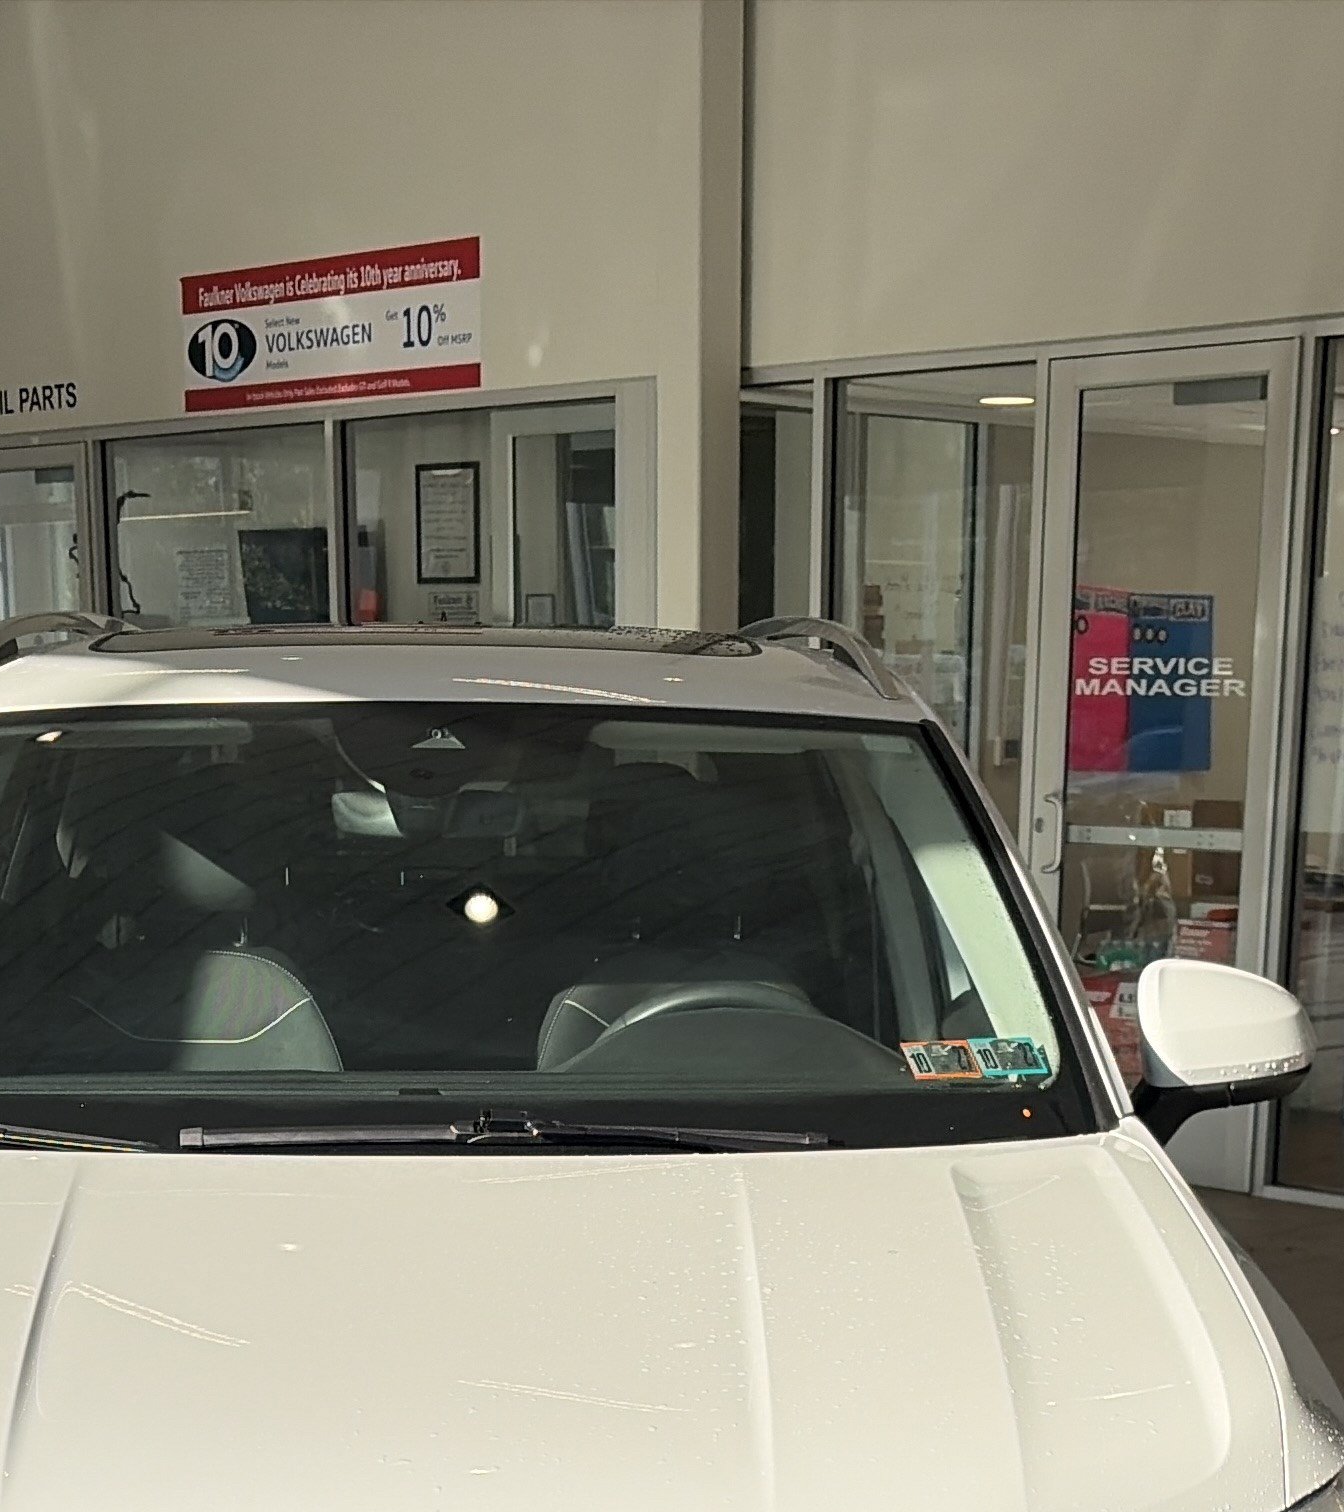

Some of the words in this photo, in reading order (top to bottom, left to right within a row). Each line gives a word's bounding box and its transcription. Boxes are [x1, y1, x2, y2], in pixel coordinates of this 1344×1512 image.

[198, 285, 234, 308] Faulkner
[234, 281, 285, 304] Volkswagen
[285, 275, 294, 297] is
[295, 269, 345, 296] Celebrating
[359, 263, 382, 287] 10th
[382, 265, 402, 290] year
[404, 257, 461, 282] anniversary.
[265, 322, 372, 354] VOLKSWAGEN
[19, 382, 77, 414] PARTS
[1088, 657, 1234, 676] SERVICE
[1074, 678, 1247, 697] MANAGER
[909, 1052, 933, 1074] 10
[976, 1048, 1000, 1070] 10
